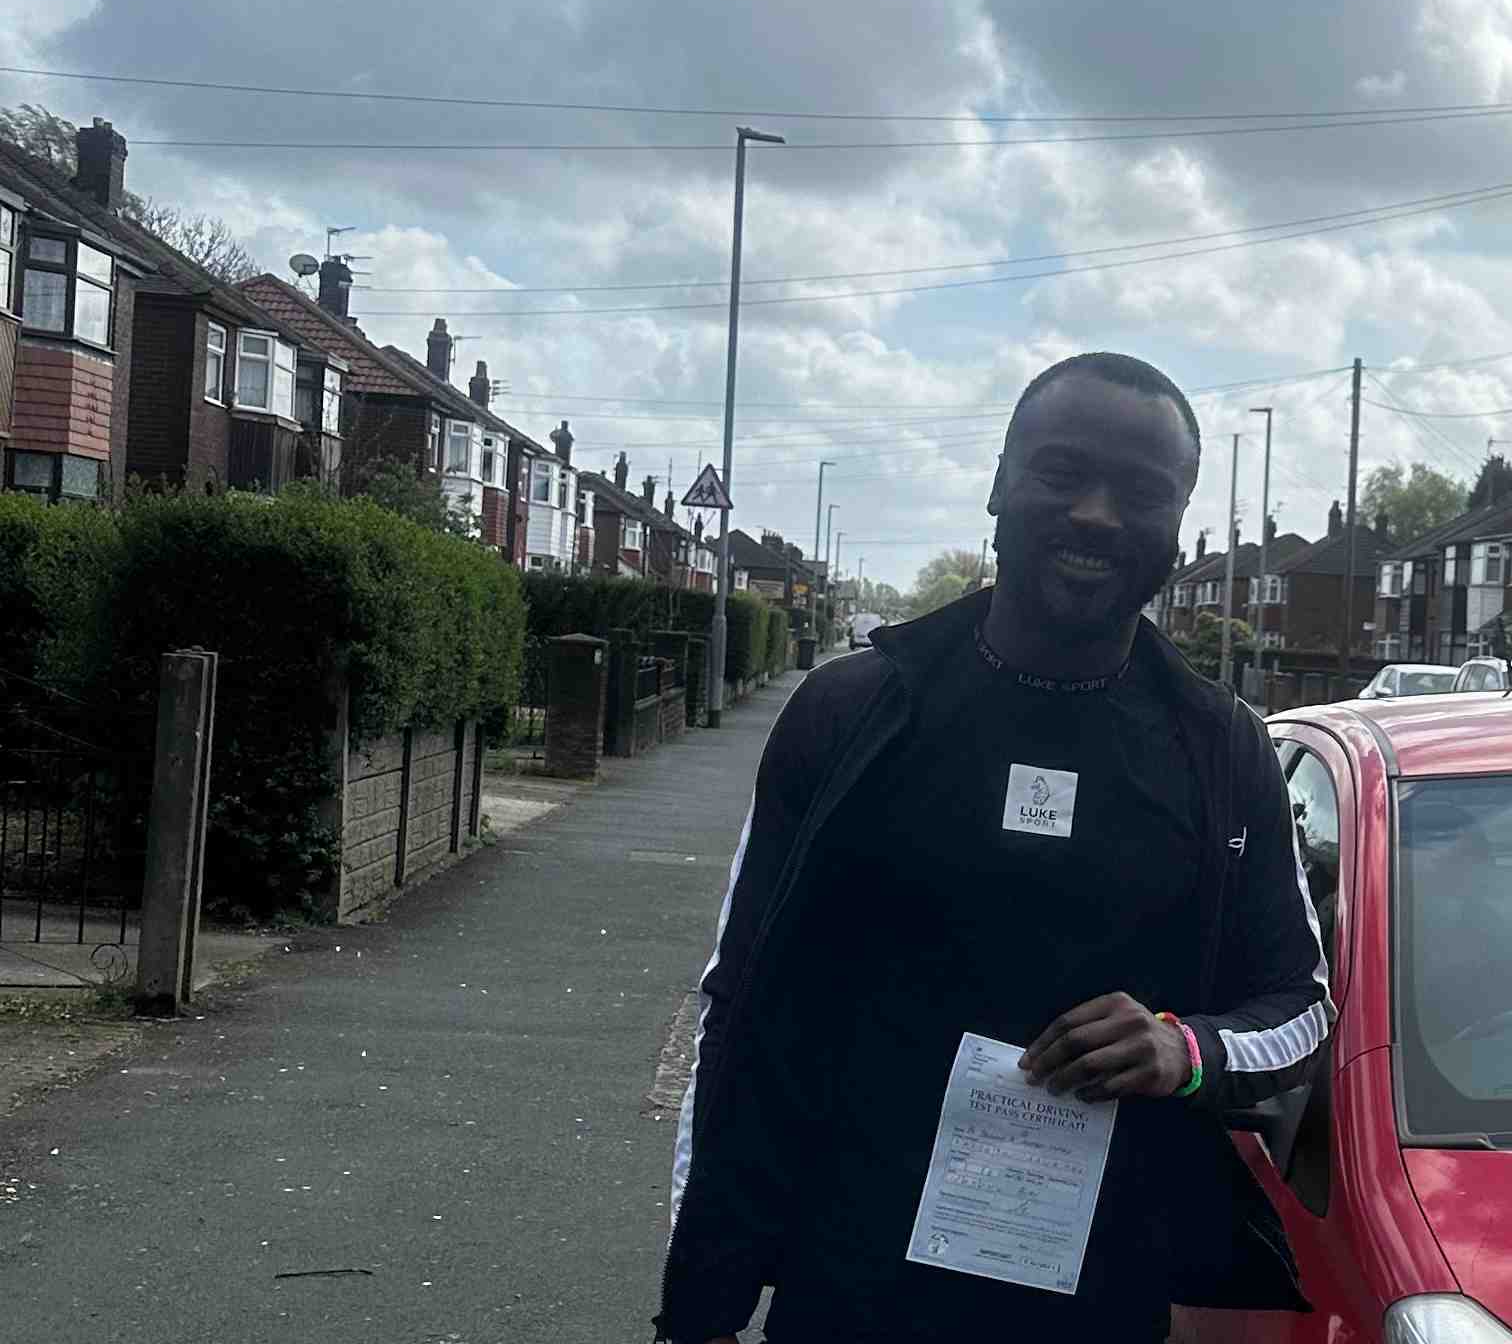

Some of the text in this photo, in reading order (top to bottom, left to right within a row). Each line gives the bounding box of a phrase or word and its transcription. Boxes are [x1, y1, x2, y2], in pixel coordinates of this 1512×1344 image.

[1019, 806, 1057, 820] LUKE
[968, 1099, 993, 1113] TEST
[970, 1088, 1089, 1121] PRACTICAL DRIVING
